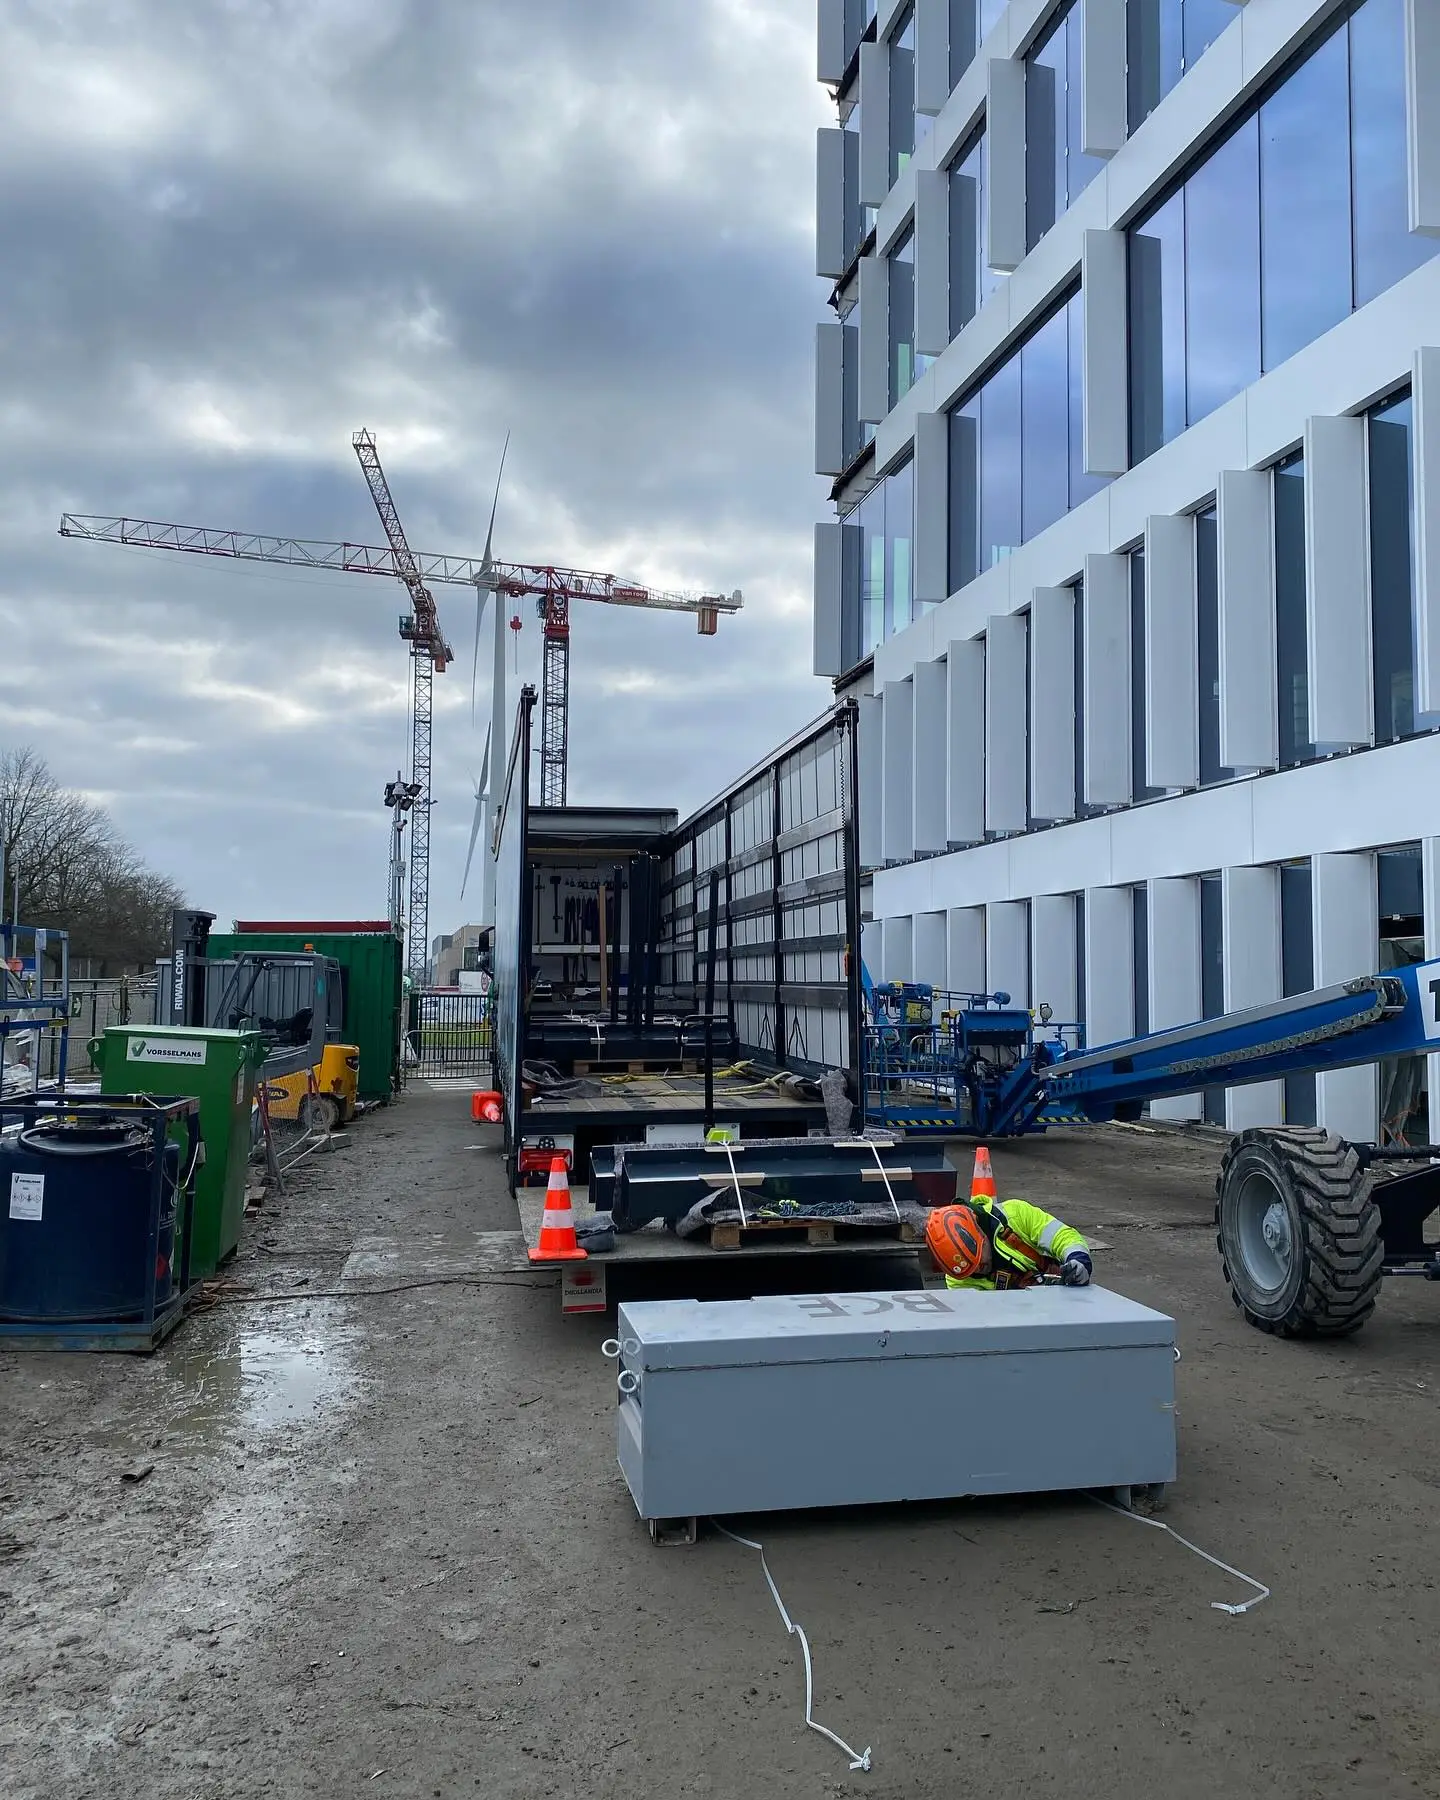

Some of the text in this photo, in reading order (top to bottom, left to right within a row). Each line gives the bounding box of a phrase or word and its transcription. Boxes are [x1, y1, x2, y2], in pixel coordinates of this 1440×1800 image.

[146, 1048, 202, 1058] VORSSELMANS
[564, 1287, 603, 1296] DHOLLANDIA
[789, 1293, 955, 1319] BCE
